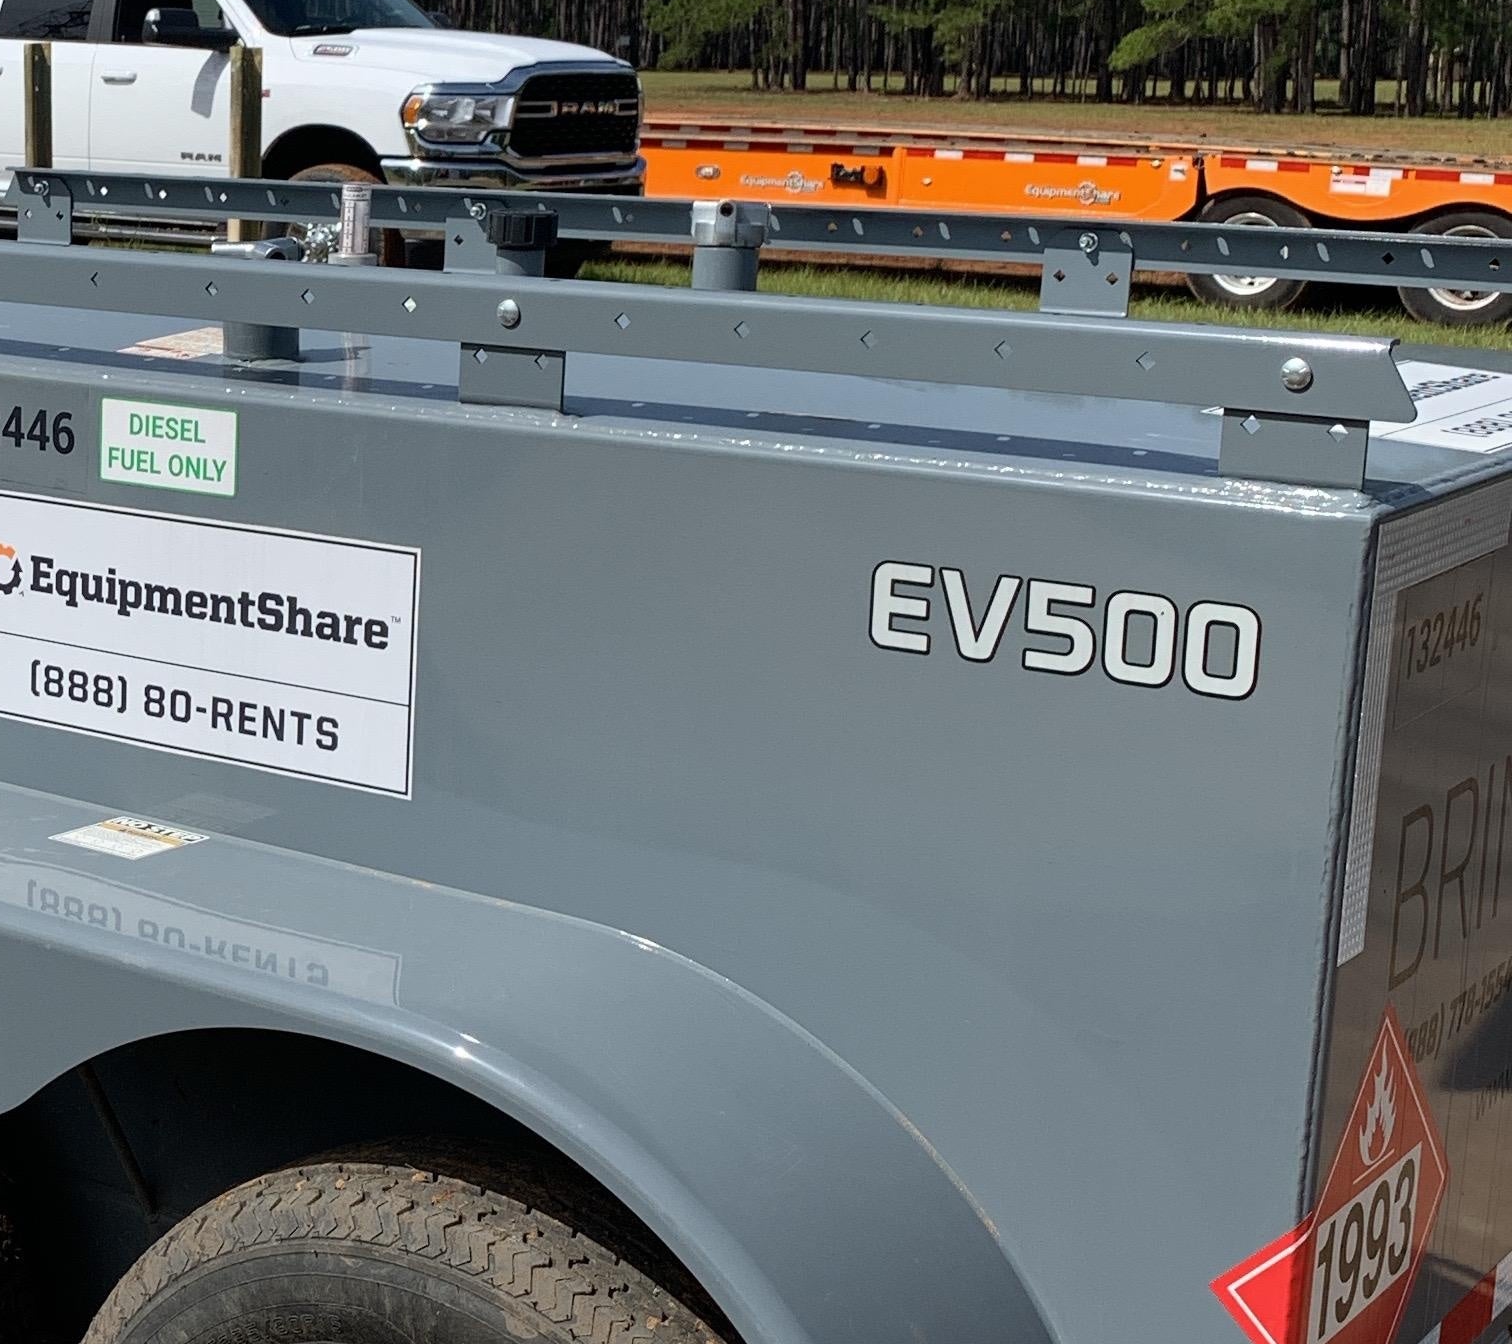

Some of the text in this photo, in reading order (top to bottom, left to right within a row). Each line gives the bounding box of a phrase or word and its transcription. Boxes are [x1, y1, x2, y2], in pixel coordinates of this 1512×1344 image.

[561, 101, 615, 115] RAM
[180, 152, 222, 162] RAM
[107, 446, 228, 484] FUEL ONLY
[128, 412, 207, 445] DIESEL
[29, 554, 391, 652] EquipmentShare
[867, 558, 1263, 702] EV500
[1404, 591, 1483, 681] 132446
[29, 659, 341, 754] (888) 80-RENTS
[1316, 1155, 1417, 1343] 1993
